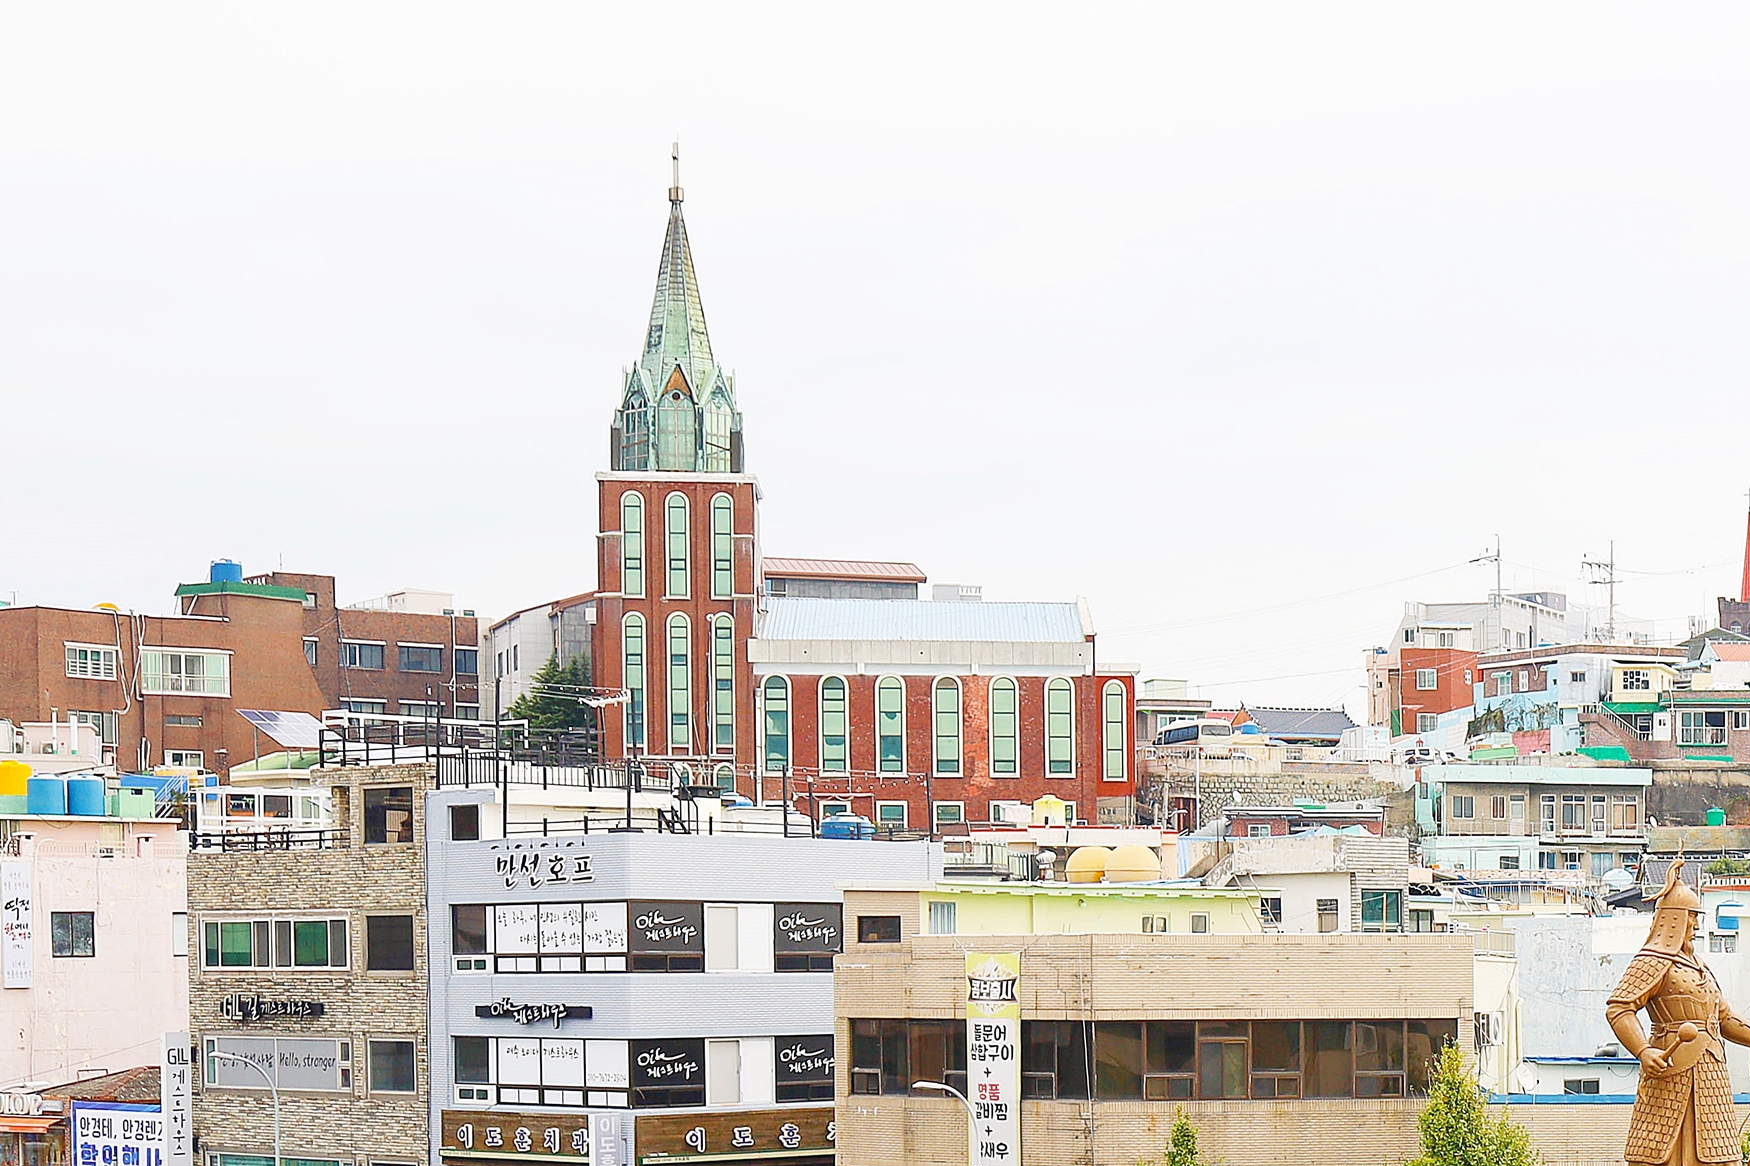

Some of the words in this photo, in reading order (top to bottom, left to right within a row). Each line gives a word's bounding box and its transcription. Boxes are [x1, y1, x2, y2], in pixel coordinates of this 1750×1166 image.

[496, 853, 594, 888] 만선호프
[971, 979, 1013, 1000] 콤보출시
[223, 994, 243, 1020] GIL
[246, 996, 260, 1020] 길
[260, 1000, 312, 1020] 게스트하우스
[974, 1023, 1006, 1042] 돌문어
[167, 1047, 189, 1065] GIL
[279, 1052, 301, 1069] Hello,
[970, 1043, 1014, 1061] 삼합구이
[978, 1083, 1000, 1101] 명품
[172, 1068, 186, 1156] 게스트하우스
[975, 1101, 1008, 1121] 갈비찜
[79, 1117, 118, 1140] 안경테,
[456, 1123, 588, 1154] 이도훈치과
